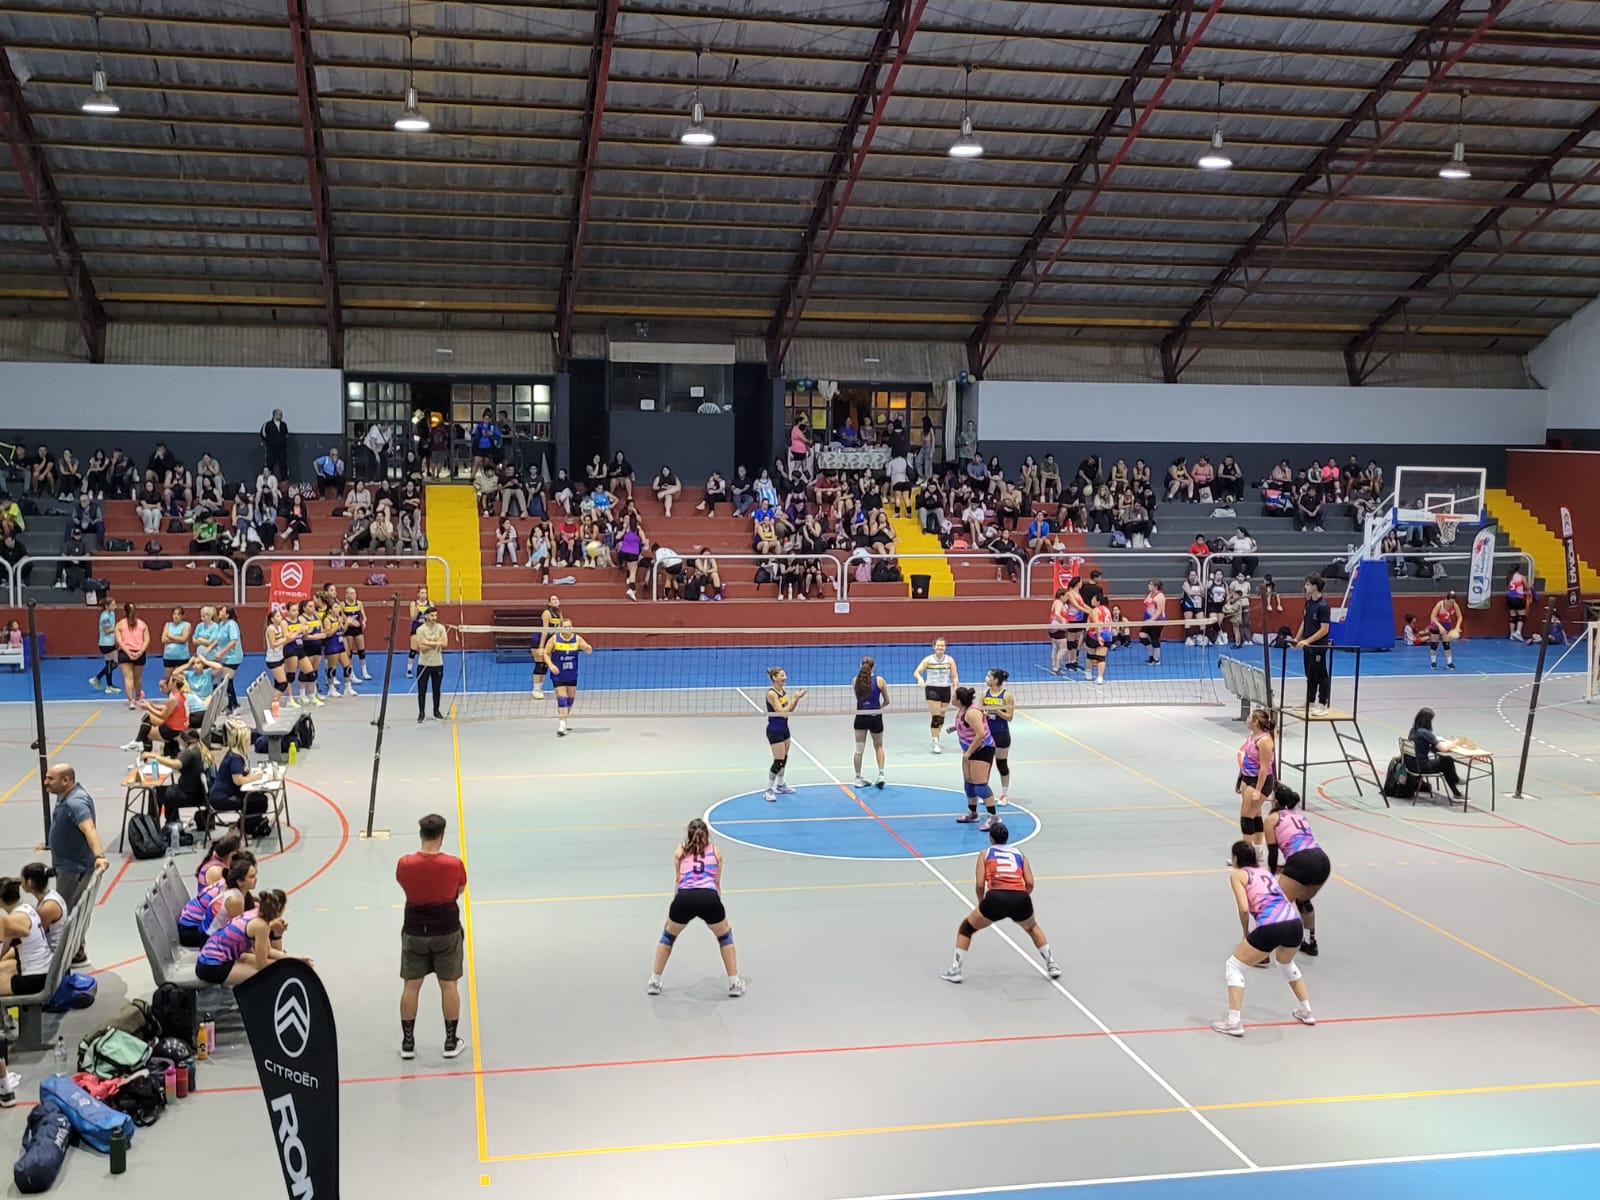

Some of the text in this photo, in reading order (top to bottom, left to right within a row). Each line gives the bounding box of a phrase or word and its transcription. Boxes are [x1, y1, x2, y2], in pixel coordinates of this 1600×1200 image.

[1566, 538, 1577, 584] ROMA
[1290, 816, 1307, 834] 4
[693, 852, 705, 874] 5
[993, 851, 1018, 873] 3
[1260, 875, 1281, 896] 2
[264, 1058, 319, 1090] CITROËN
